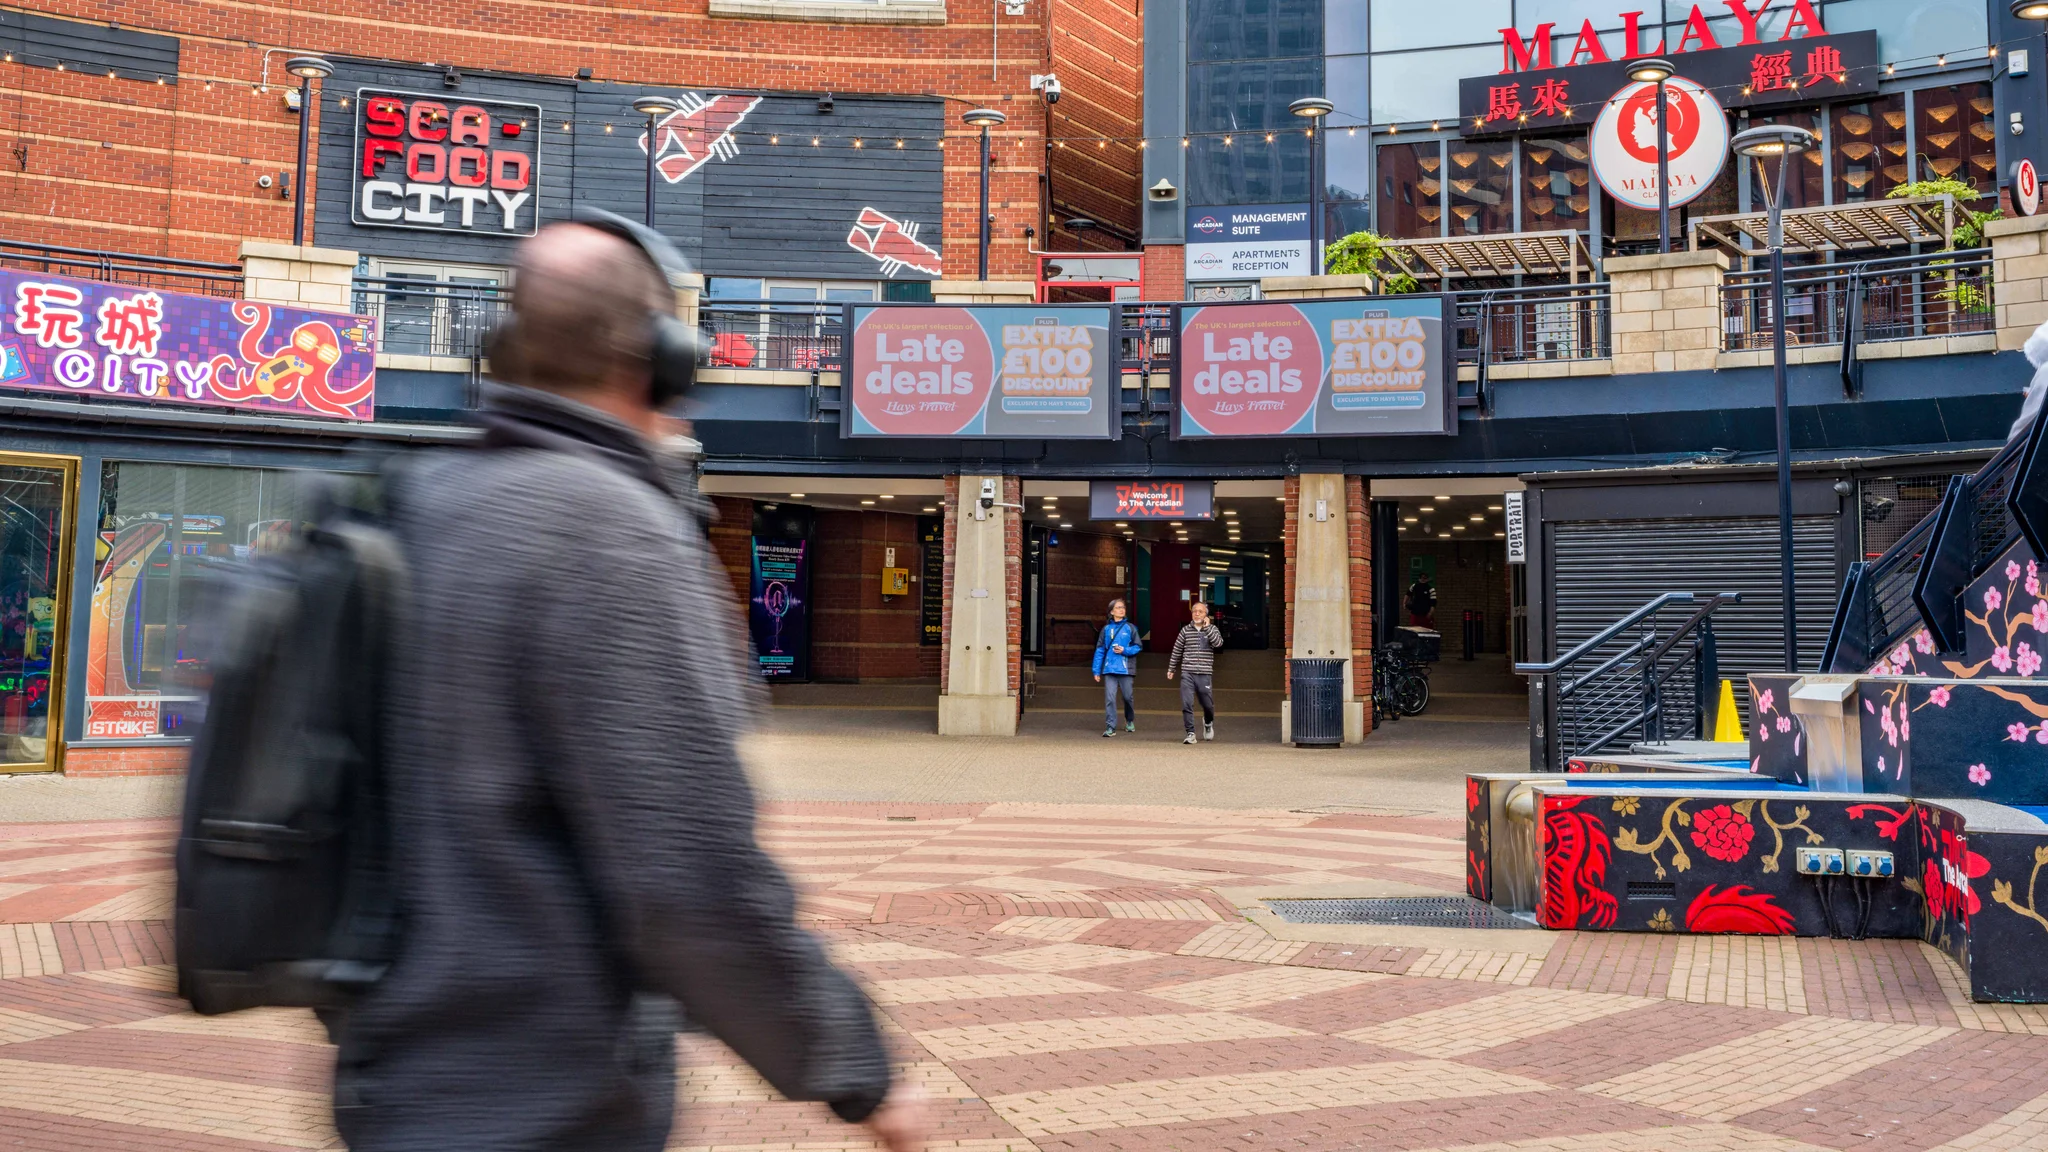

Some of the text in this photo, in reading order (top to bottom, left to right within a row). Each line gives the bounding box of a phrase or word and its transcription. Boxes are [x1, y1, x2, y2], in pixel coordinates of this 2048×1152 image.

[1498, 0, 1829, 75] MALAYA
[1486, 46, 1847, 122] 馬來 經典
[363, 138, 531, 191] FOOD
[1643, 190, 1677, 199] CLAIC
[362, 181, 530, 230] CITY
[1232, 213, 1307, 223] MANAGEMENT
[1232, 226, 1260, 235] SUITE
[1232, 249, 1300, 259] APARTMENTS
[1232, 262, 1289, 270] RECEPTION
[902, 323, 928, 331] largest
[1257, 320, 1291, 328] selection
[1334, 318, 1425, 339] EXTRA
[1005, 326, 1092, 345] EXTRA
[876, 333, 965, 362] Late
[1203, 332, 1293, 362] Late
[1333, 341, 1424, 370] £100
[1004, 348, 1091, 375] £100
[57, 352, 213, 397] CITY
[865, 364, 974, 395] deals
[1005, 377, 1092, 392] DISCOUNT
[1193, 362, 1303, 395] deals
[1334, 371, 1424, 387] DISCOUNT
[886, 401, 957, 412] Hays Travel
[1214, 400, 1286, 412] Hays Travel
[1116, 481, 1185, 516] 欢迎
[1508, 498, 1523, 556] PORTRAIT
[92, 721, 155, 735] STRIKE
